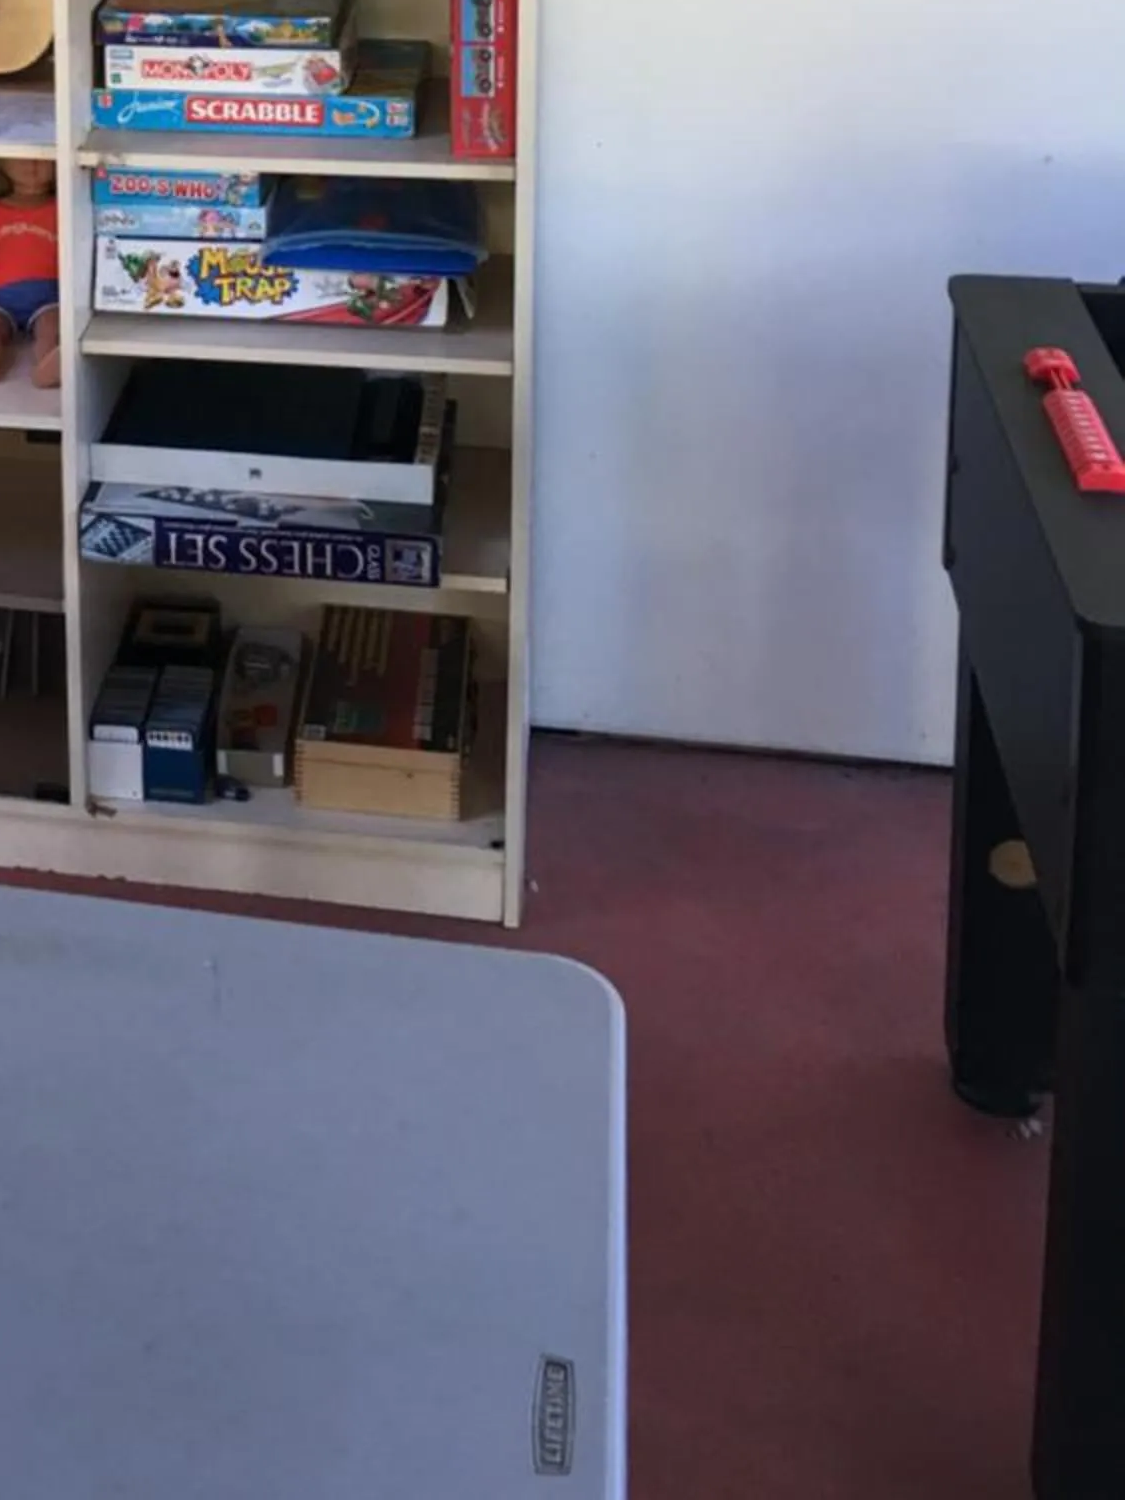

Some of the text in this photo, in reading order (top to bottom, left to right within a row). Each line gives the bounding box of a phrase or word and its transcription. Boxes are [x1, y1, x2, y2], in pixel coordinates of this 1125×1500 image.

[190, 100, 321, 124] SCRABBLE
[214, 277, 293, 305] TRAP
[164, 531, 227, 568] SET
[239, 537, 365, 578] CHESS
[543, 1364, 566, 1464] LIFETIME
